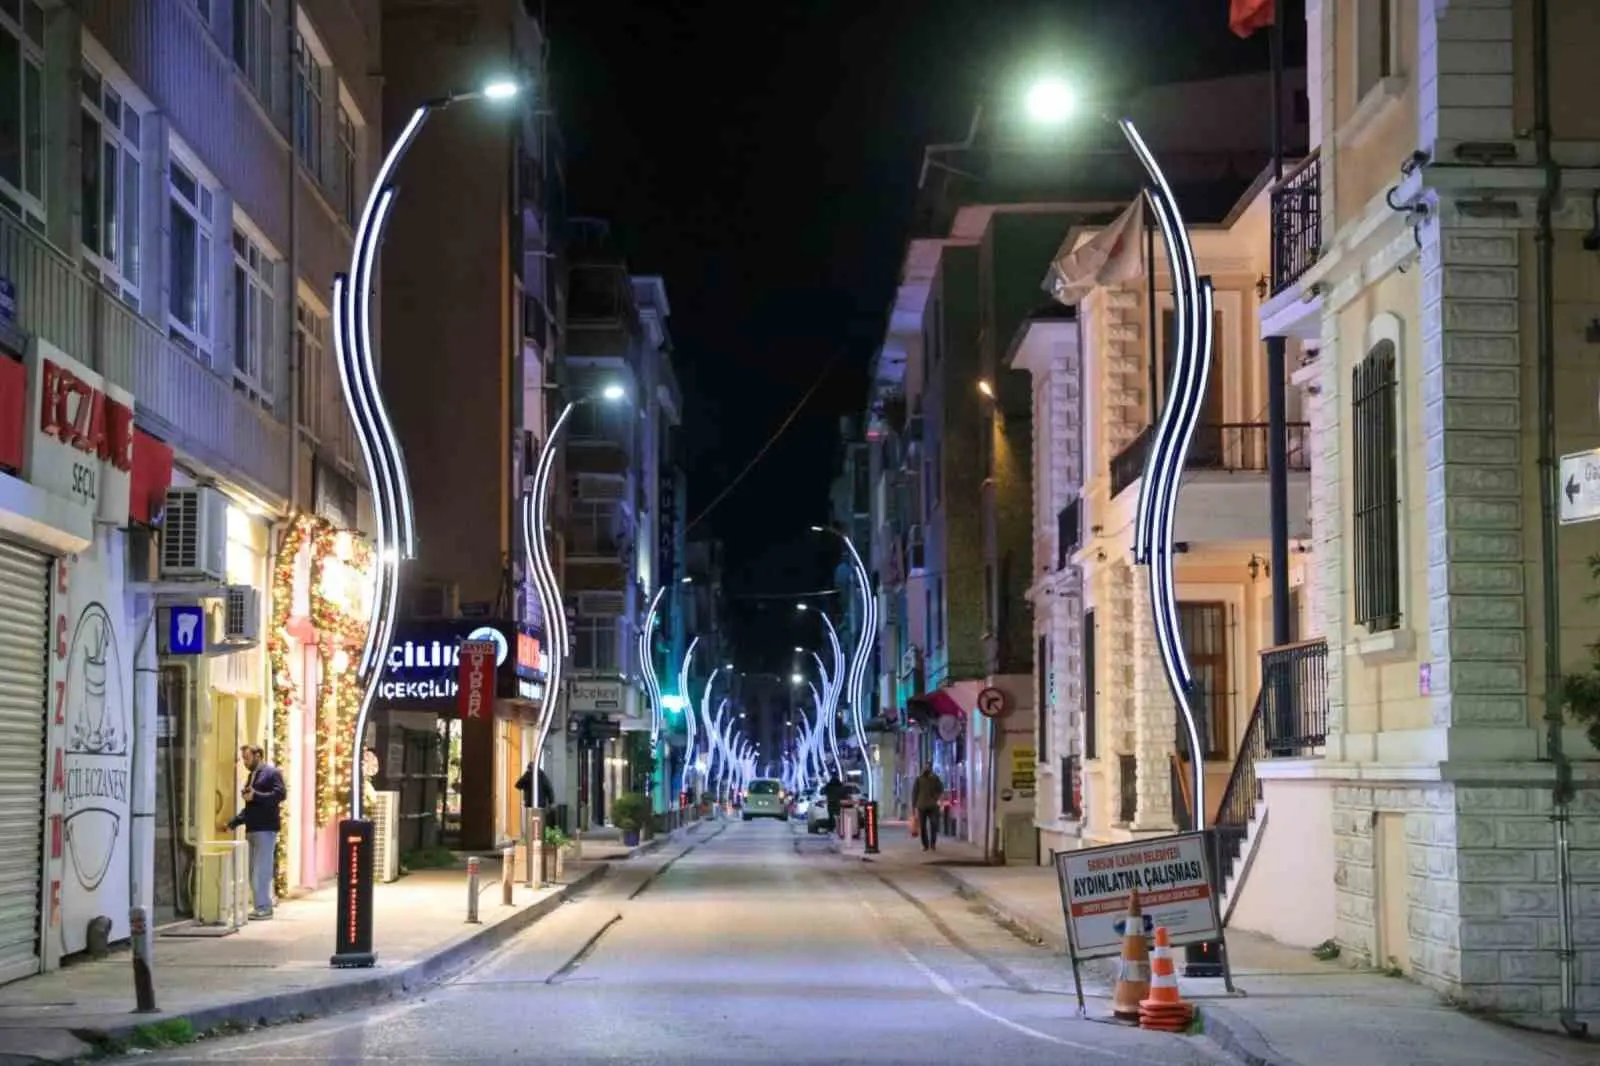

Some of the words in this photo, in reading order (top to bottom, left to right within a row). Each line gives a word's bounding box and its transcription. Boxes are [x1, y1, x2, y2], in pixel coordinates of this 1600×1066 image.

[72, 463, 96, 504] SEÇİL
[378, 678, 459, 700] İÇEKÇİLİK
[1074, 869, 1143, 897] AYDINLATMA
[1144, 860, 1202, 891] ÇALIŞMASI
